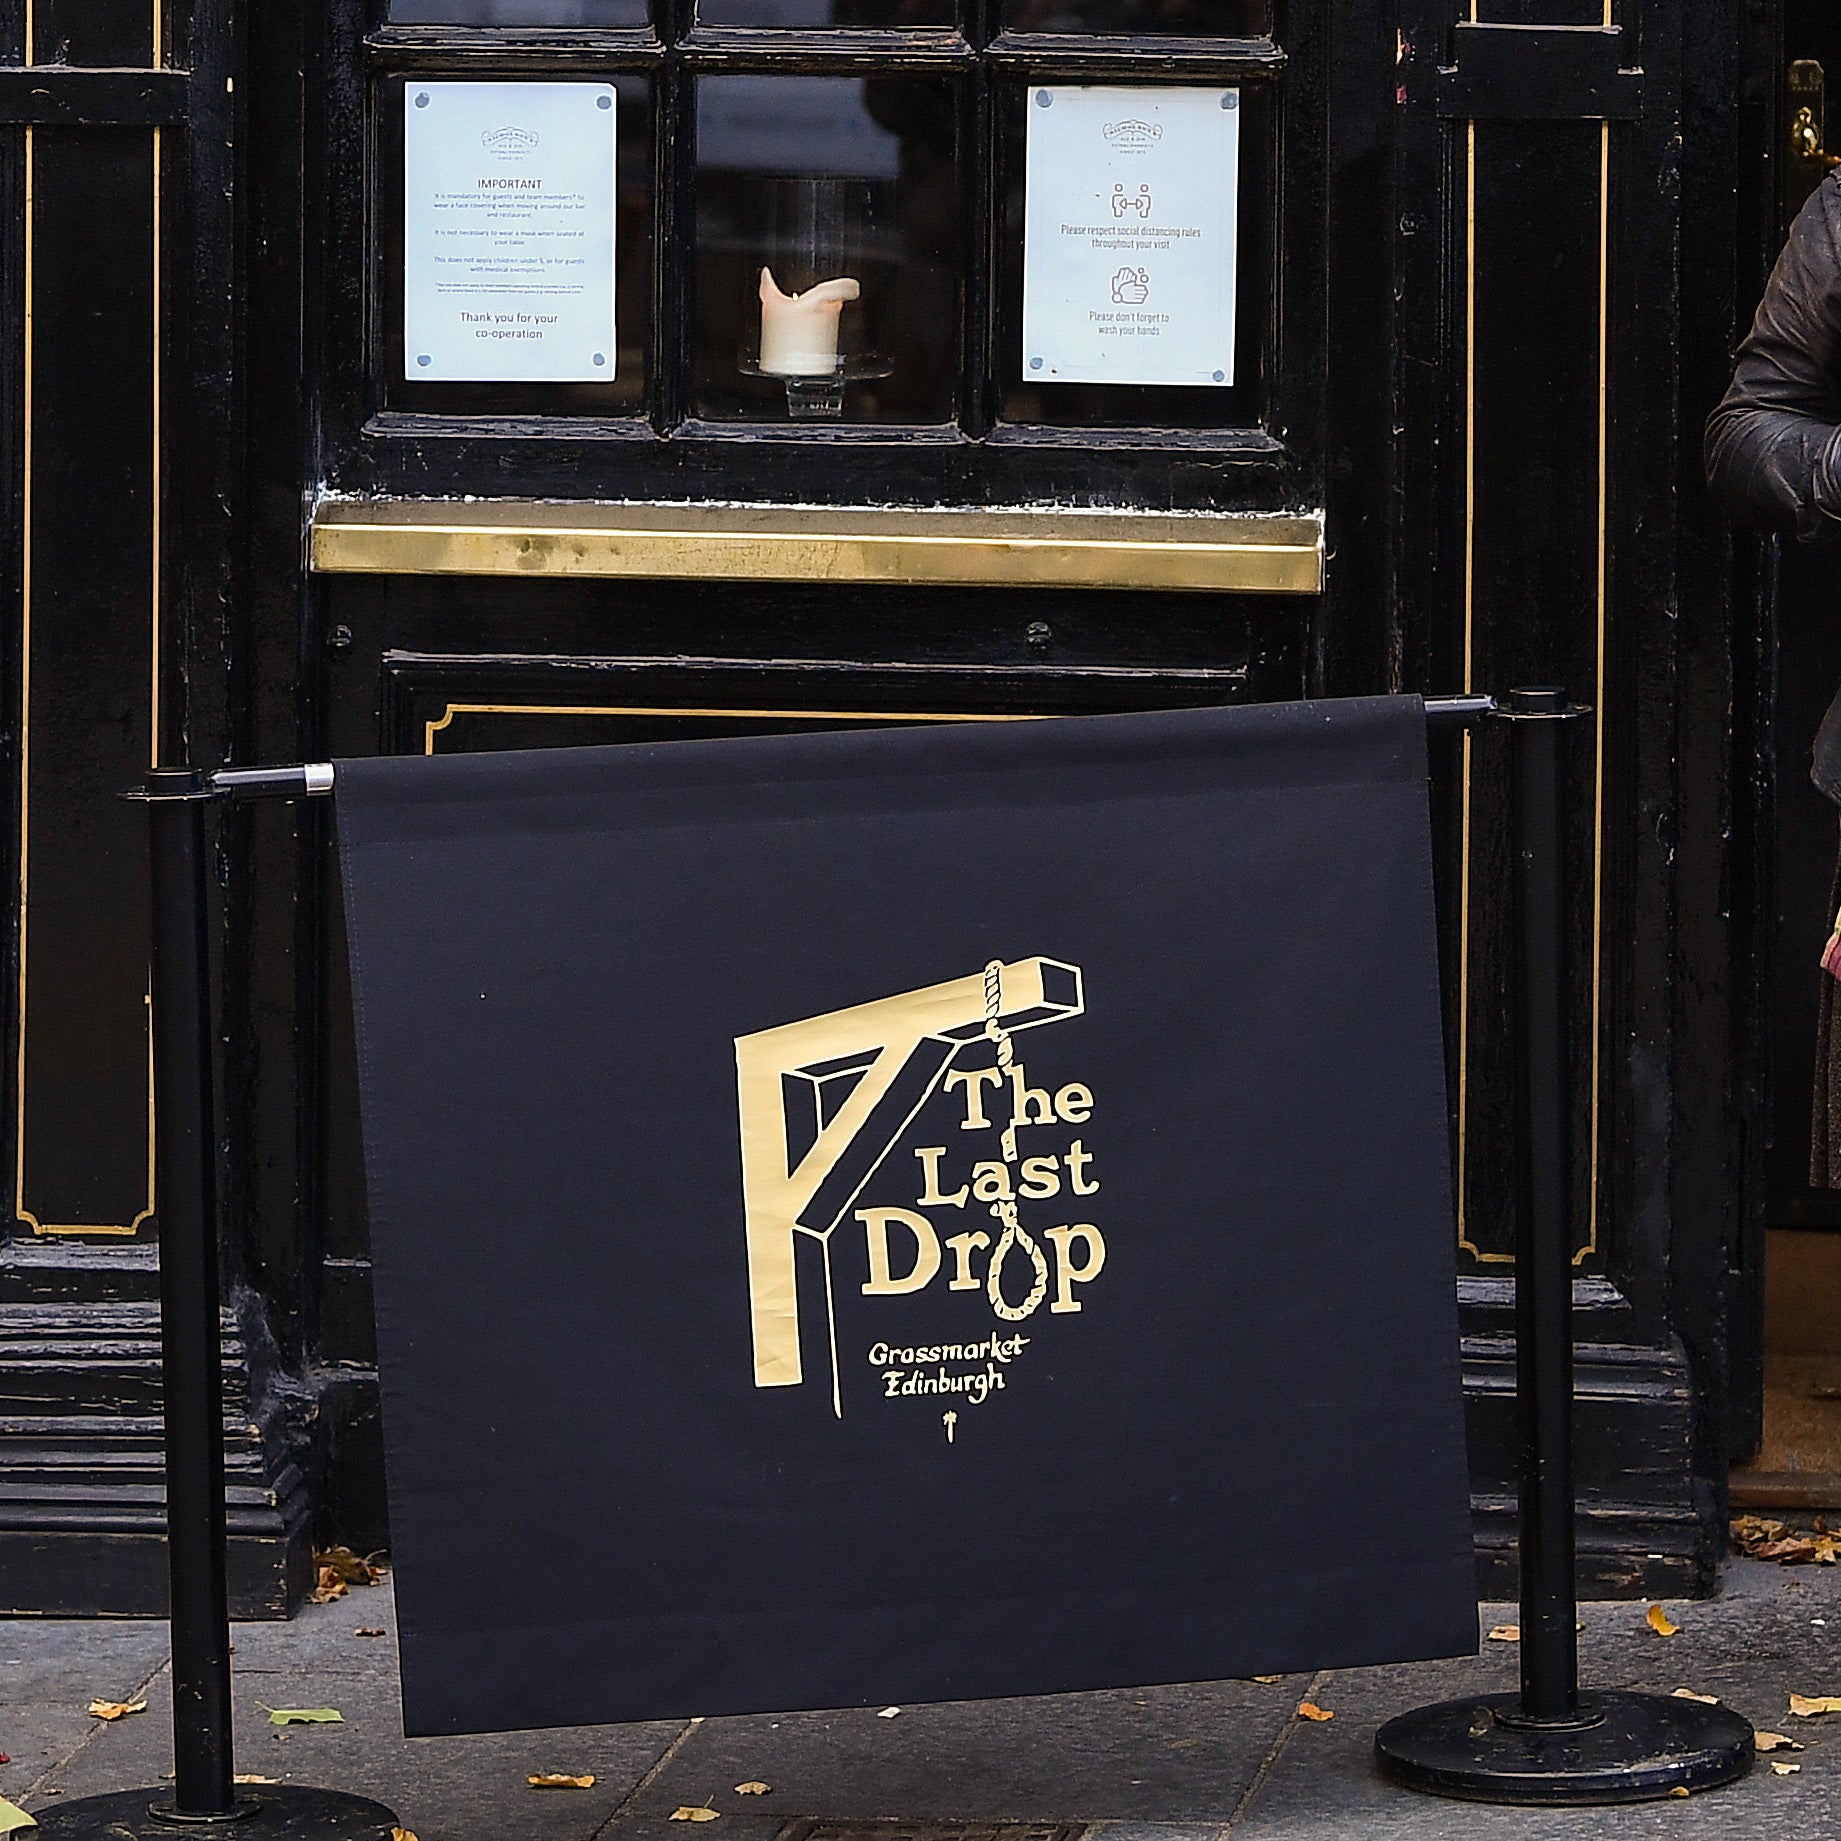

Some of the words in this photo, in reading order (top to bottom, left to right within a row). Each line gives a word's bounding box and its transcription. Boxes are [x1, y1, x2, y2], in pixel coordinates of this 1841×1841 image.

[477, 179, 543, 190] IMPORTANT
[1061, 224, 1087, 235] Please
[1087, 224, 1116, 237] respect
[1117, 225, 1140, 236] social
[1140, 226, 1181, 239] distancing
[1181, 227, 1201, 238] rules
[460, 311, 492, 323] Thank
[494, 314, 514, 324] you
[516, 312, 532, 323] for
[533, 315, 559, 325] your
[475, 329, 543, 340] co-operation
[943, 1064, 1094, 1130] The
[913, 1139, 1100, 1207] Last
[855, 1206, 1106, 1321] Drop
[881, 1363, 1006, 1404] Edinburgh
